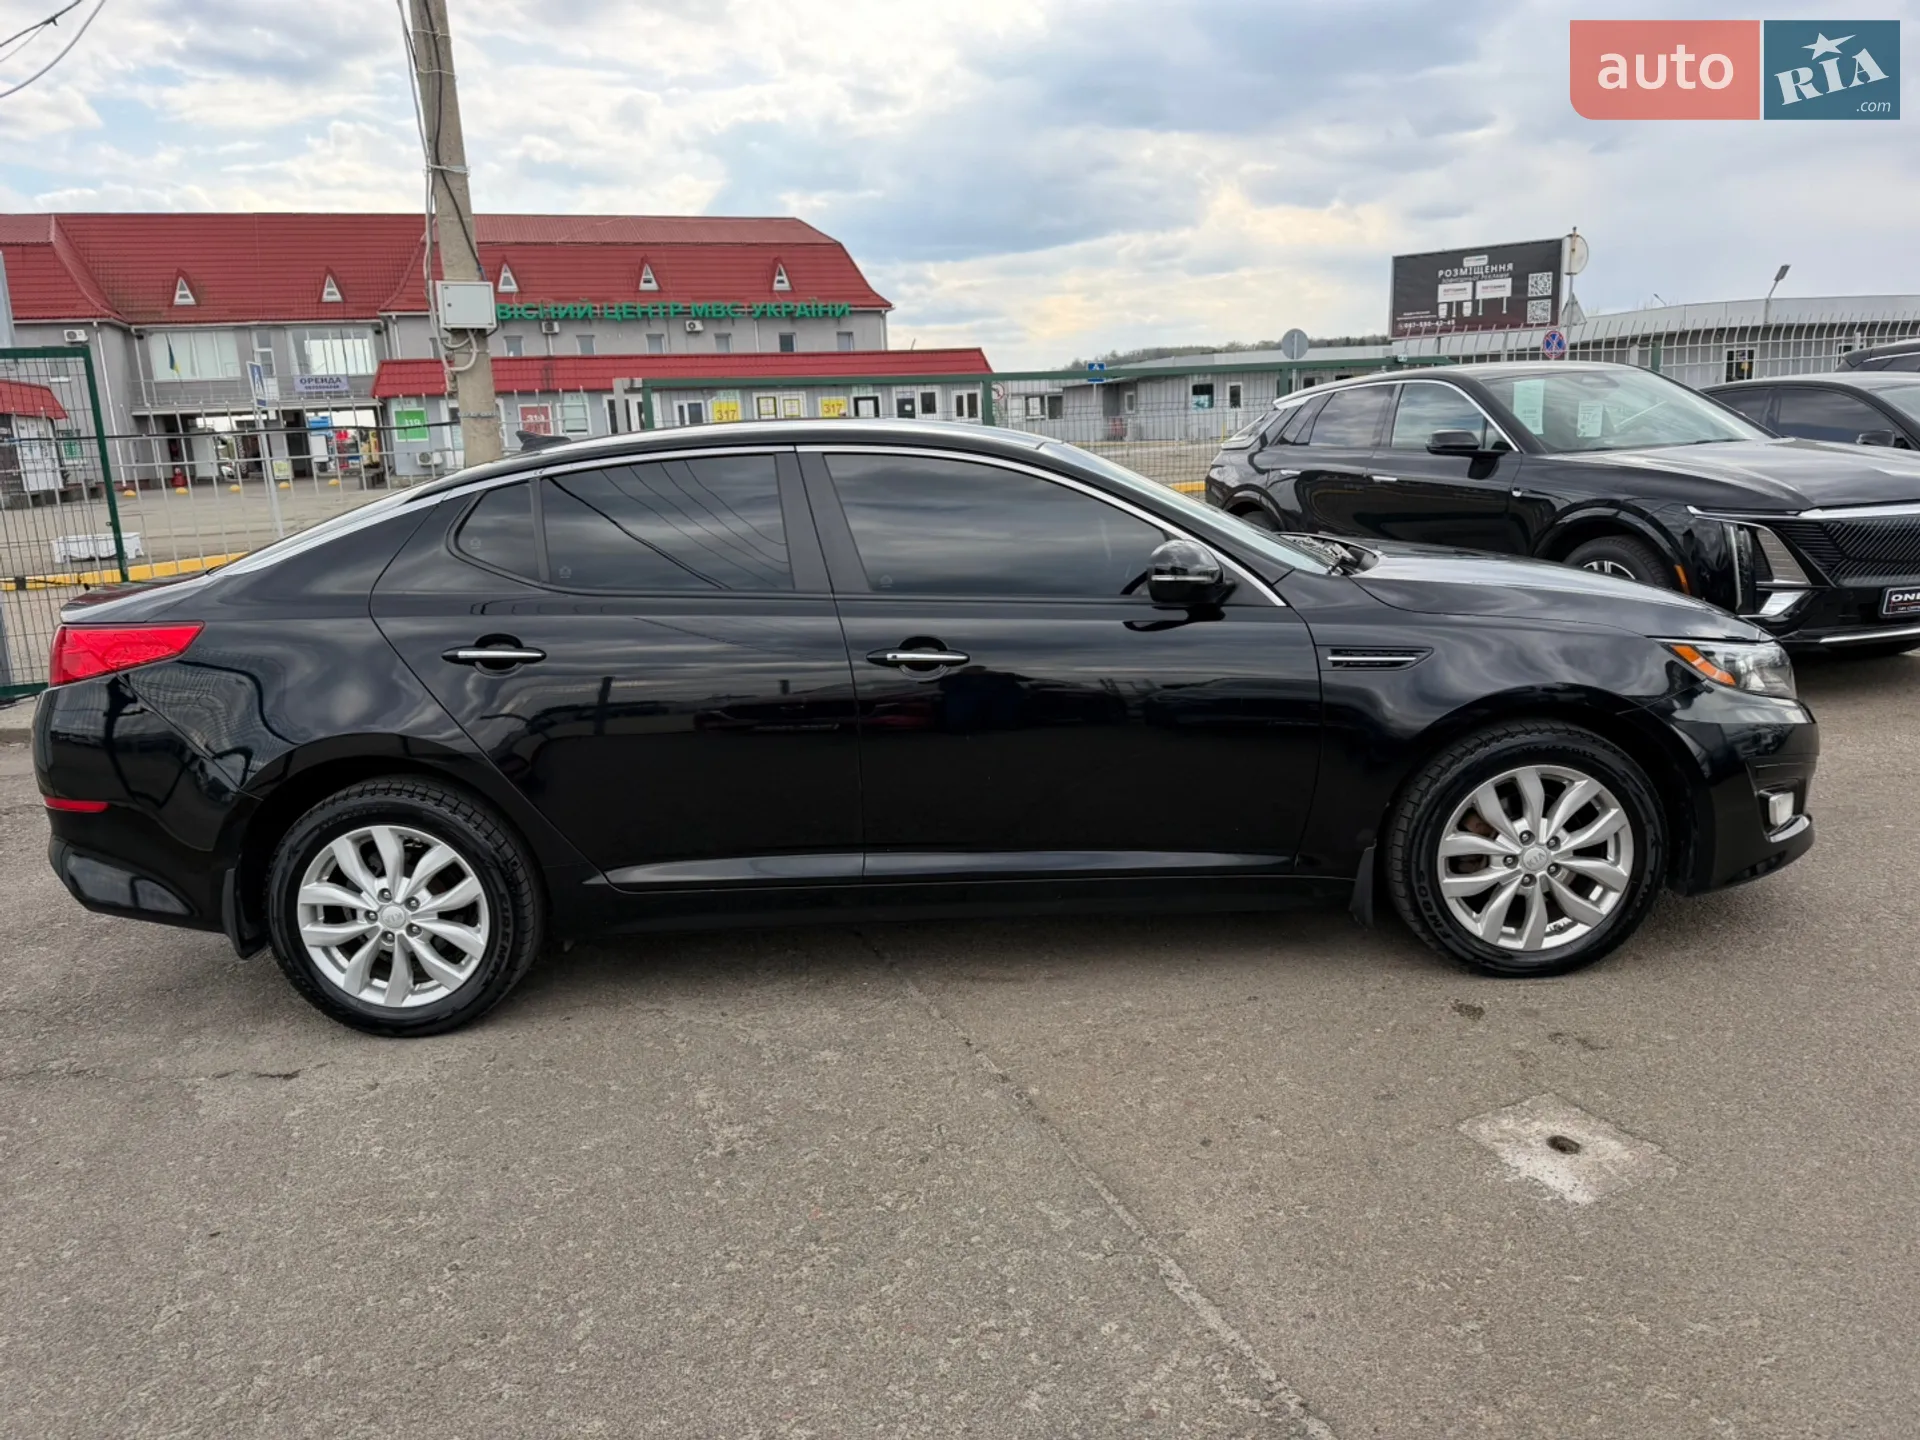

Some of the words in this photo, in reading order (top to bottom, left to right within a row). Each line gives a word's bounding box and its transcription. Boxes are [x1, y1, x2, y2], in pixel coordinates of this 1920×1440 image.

[1437, 262, 1514, 279] РОЗМІЩЕННЯ
[603, 302, 684, 322] ЦЕНТР
[690, 302, 743, 319] МВС
[751, 297, 851, 319] УКРАЇНИ
[299, 376, 342, 385] ОРЕНДА
[823, 403, 843, 414] 317
[716, 409, 737, 421] 317
